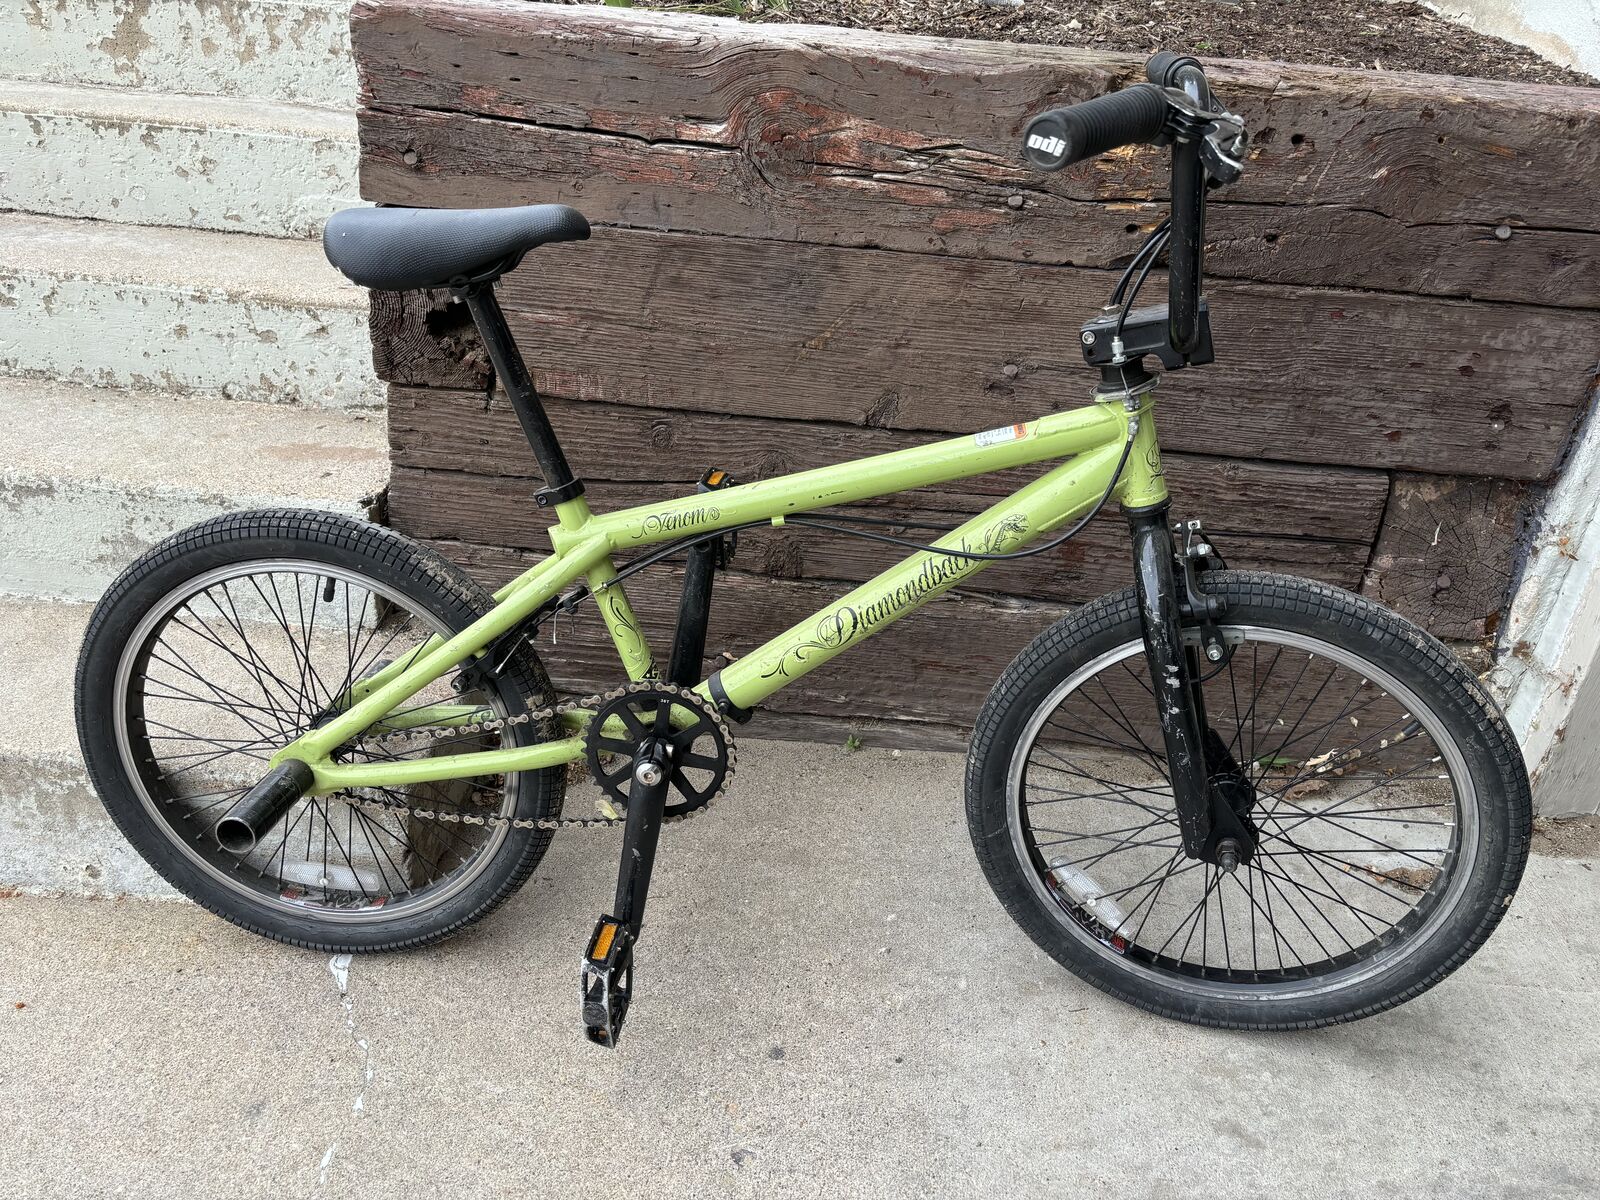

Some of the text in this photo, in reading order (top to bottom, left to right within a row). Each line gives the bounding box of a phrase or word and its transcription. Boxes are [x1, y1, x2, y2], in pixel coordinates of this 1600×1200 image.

[1027, 134, 1066, 157] odi
[634, 507, 709, 538] Venom
[816, 536, 978, 649] Diamondback
